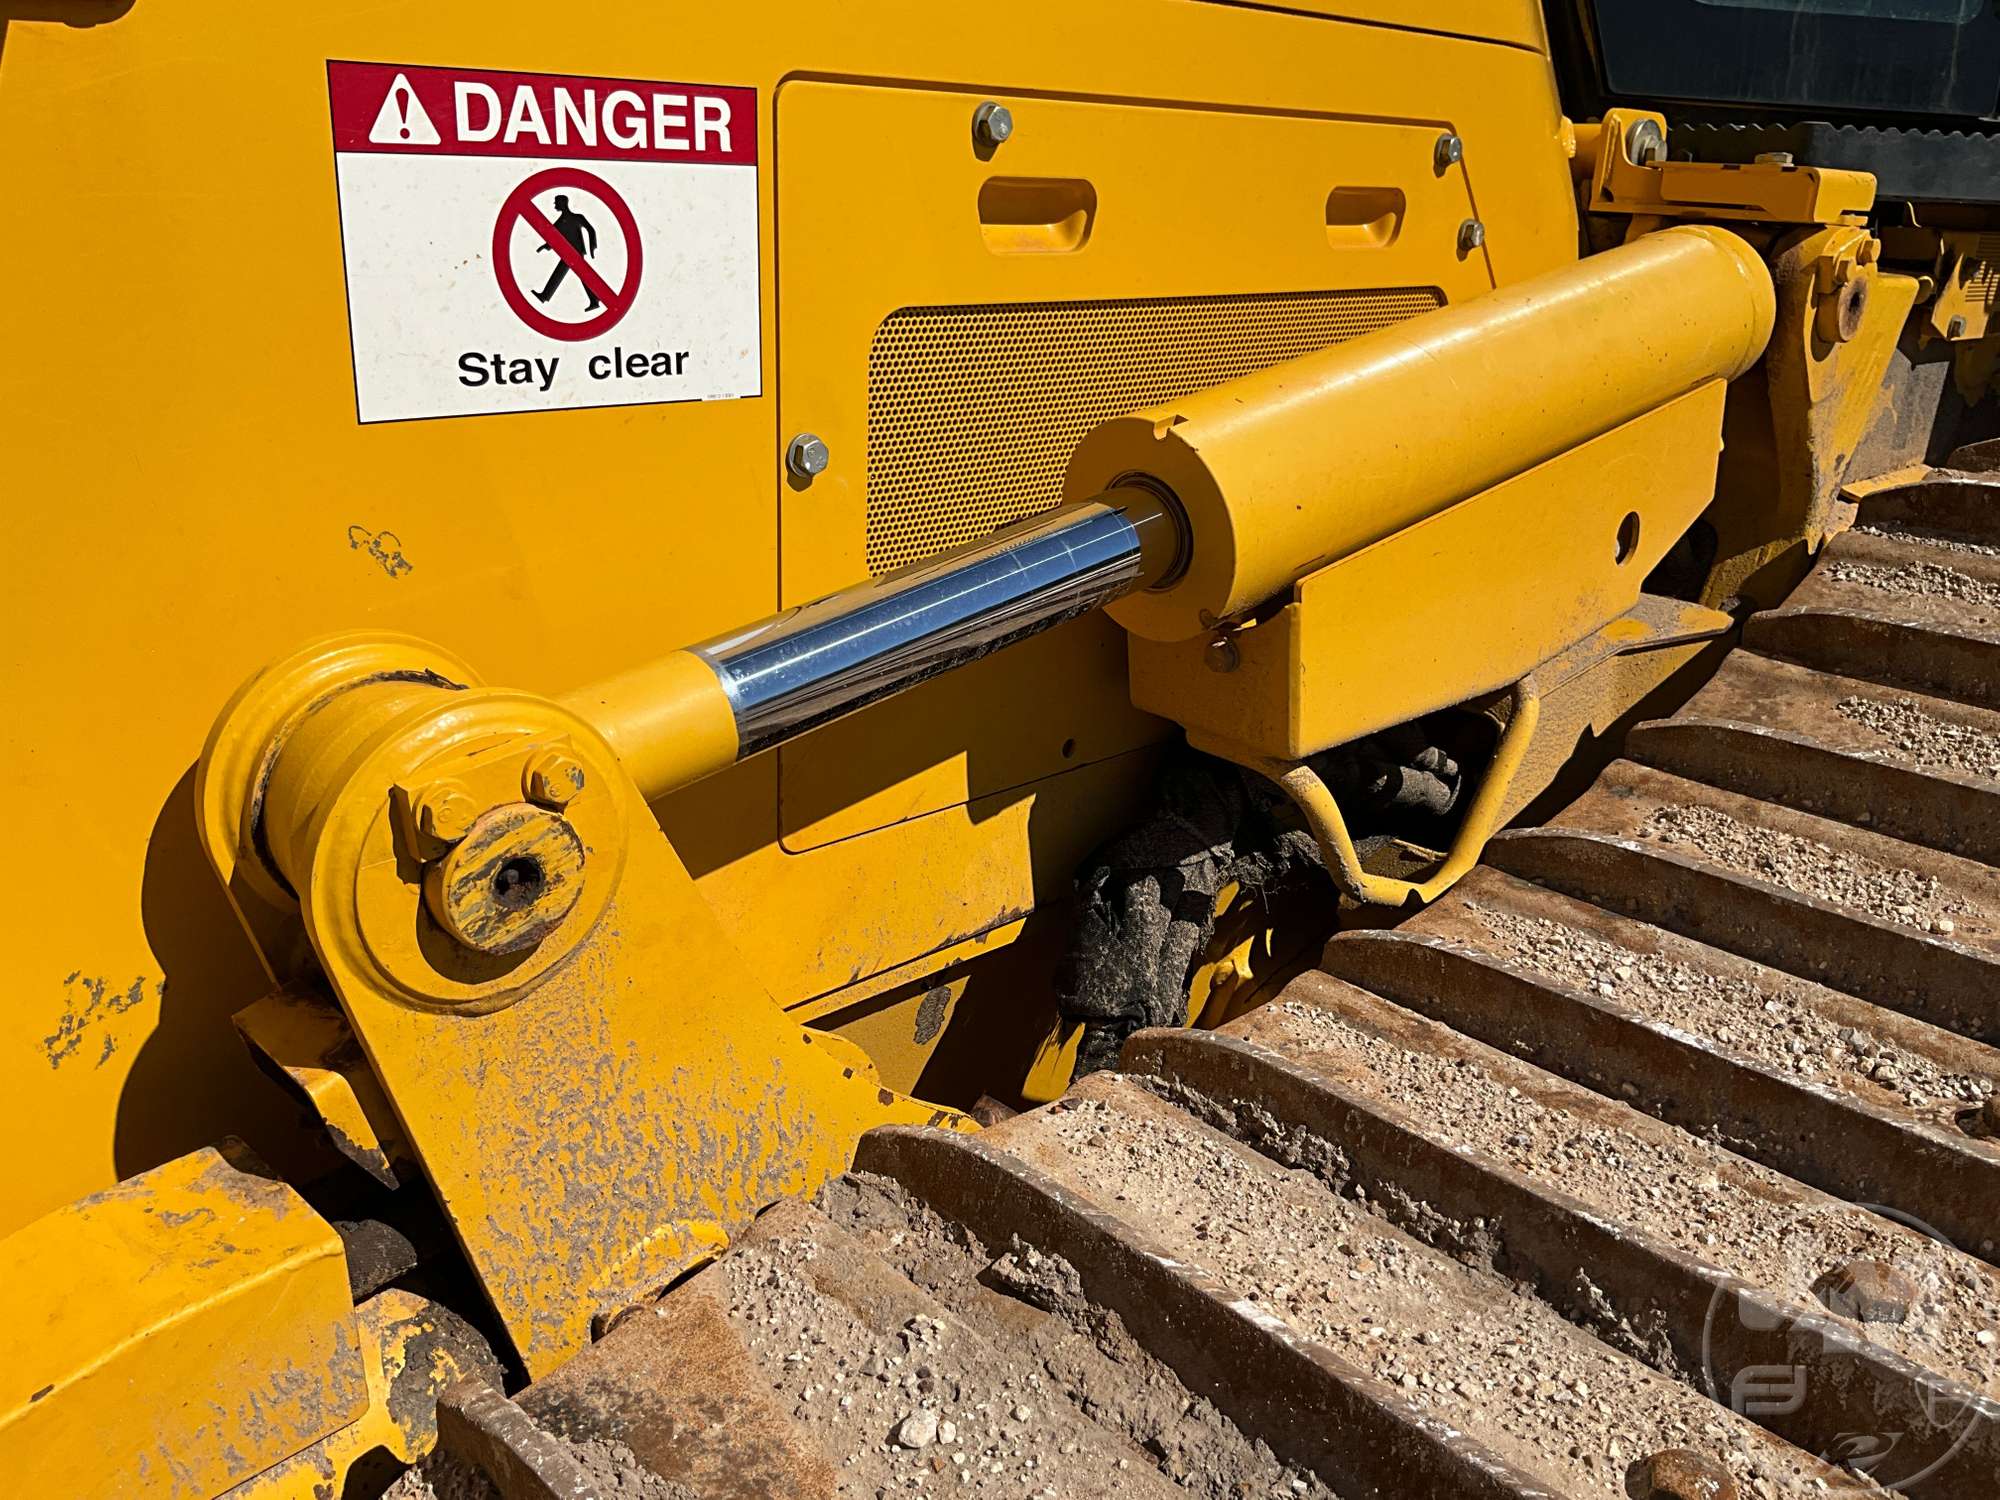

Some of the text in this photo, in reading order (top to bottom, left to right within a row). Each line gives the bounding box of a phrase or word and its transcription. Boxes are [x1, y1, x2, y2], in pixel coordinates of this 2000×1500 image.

[454, 81, 733, 153] DANGER
[458, 346, 690, 392] Stay clear
